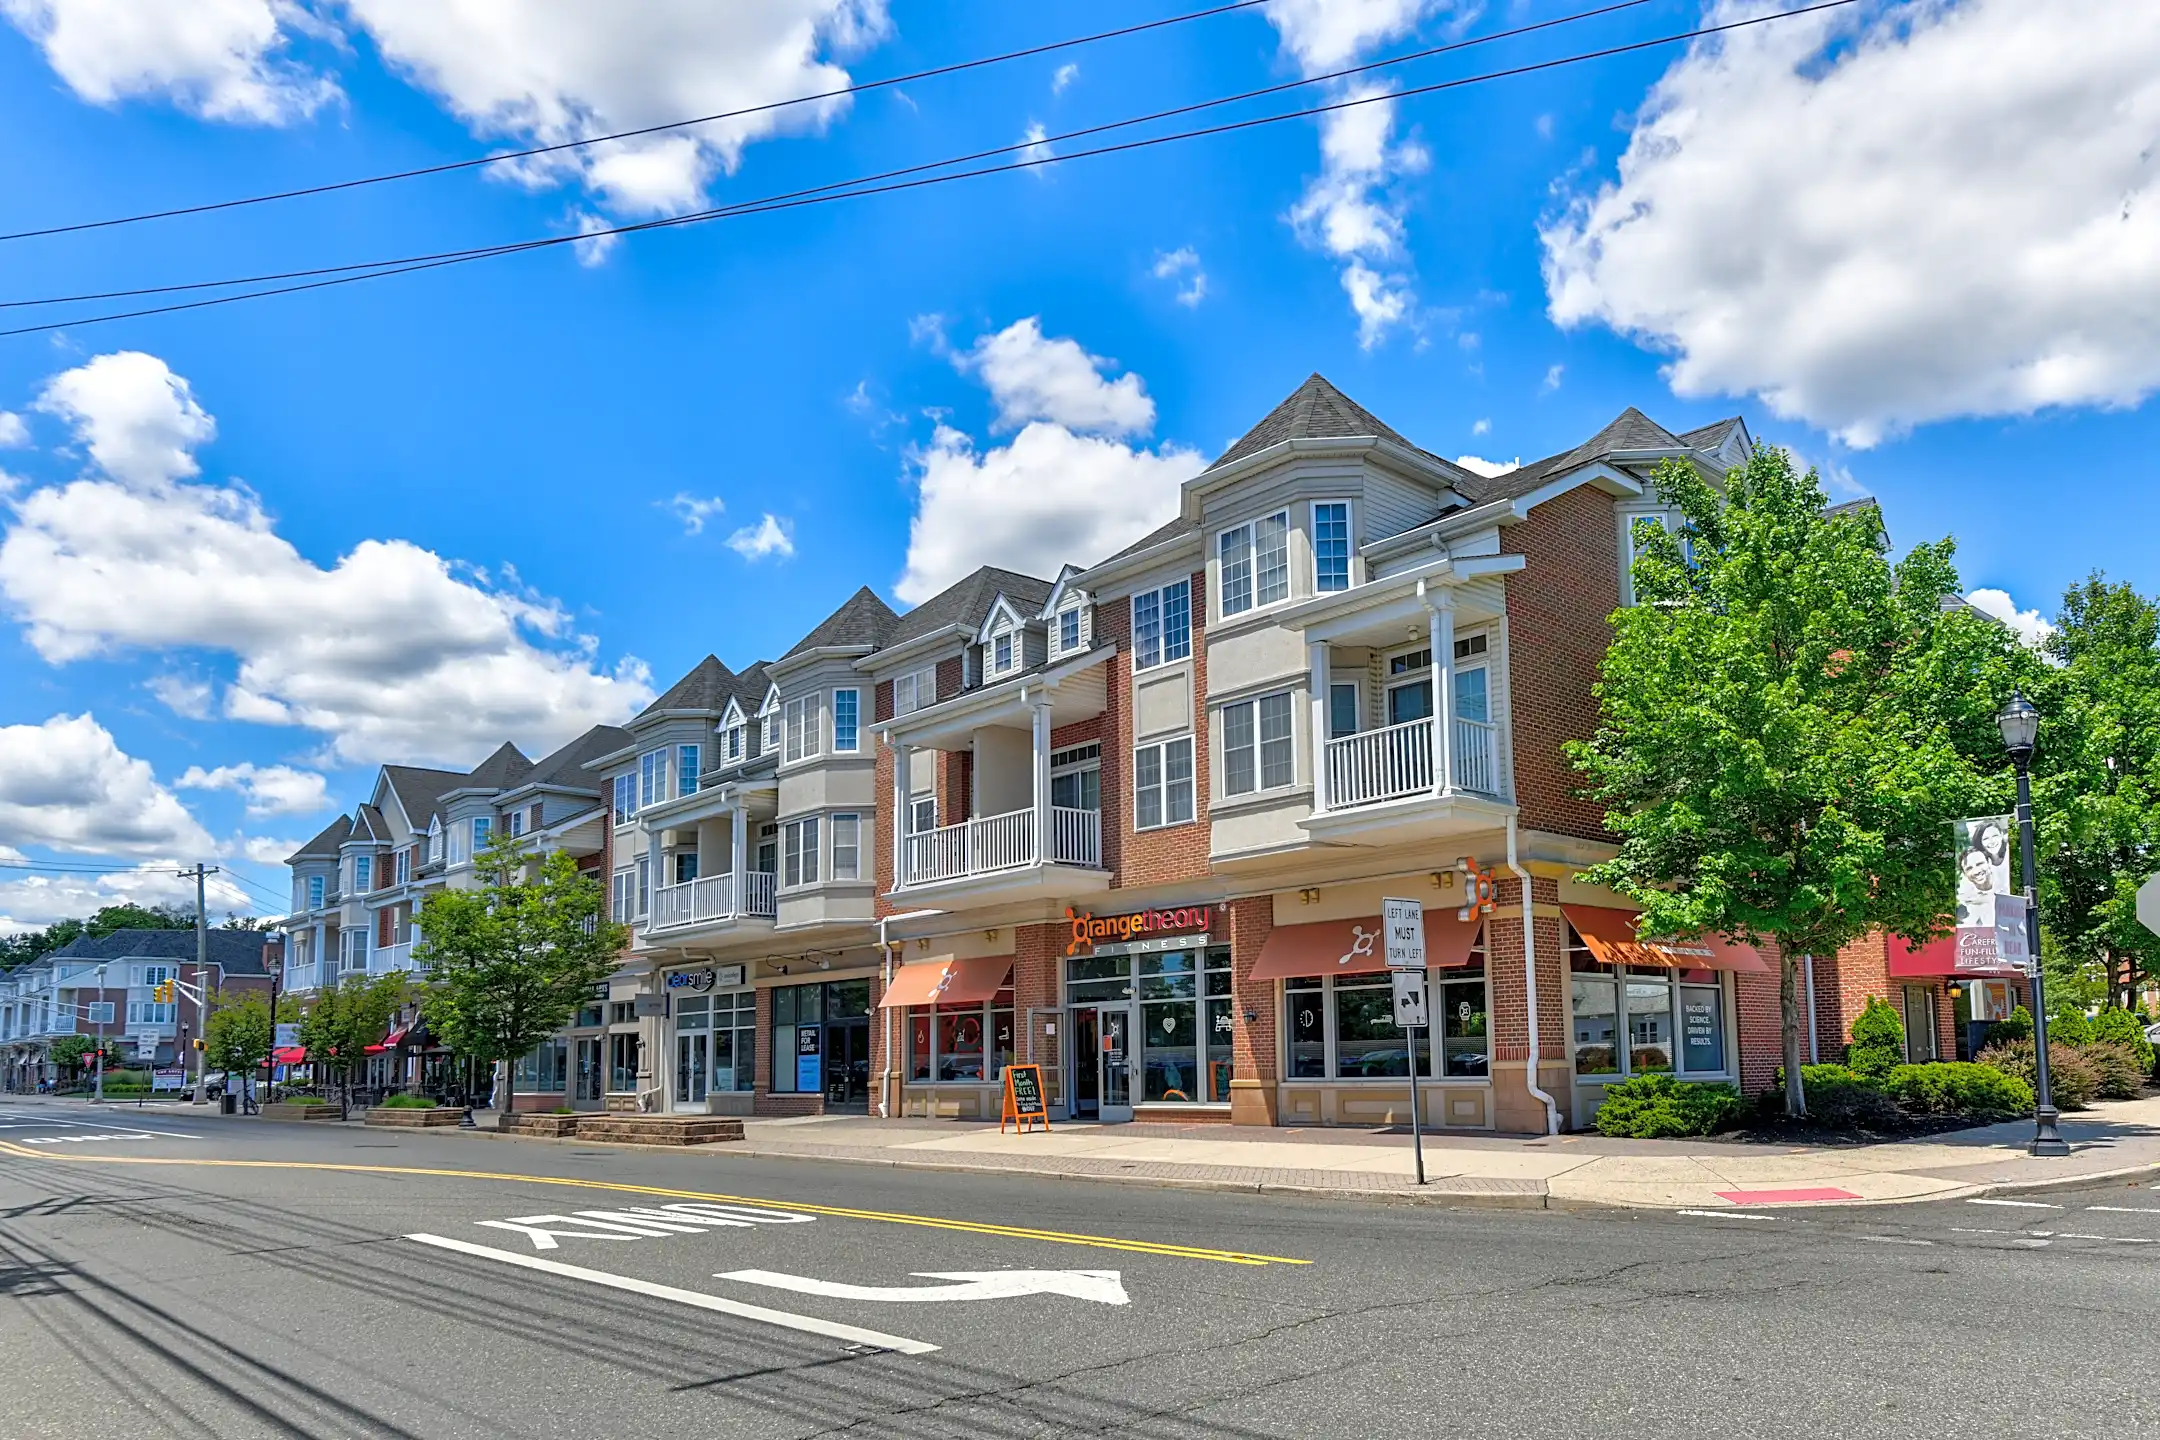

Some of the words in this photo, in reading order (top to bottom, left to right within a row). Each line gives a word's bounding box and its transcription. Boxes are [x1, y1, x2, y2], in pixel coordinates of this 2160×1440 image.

[1387, 908, 1402, 919] LEFT
[1405, 909, 1420, 920] LANE
[1395, 926, 1415, 940] MUST
[1094, 936, 1207, 956] FITNESS
[1389, 947, 1406, 959] TURN
[1408, 948, 1422, 959] LEFT
[1685, 1004, 1704, 1013] BACKED
[1705, 1005, 1711, 1013] BY
[801, 1029, 816, 1037] RETAIL
[1687, 1026, 1705, 1035] DRIVEN
[1705, 1026, 1712, 1035] BY
[801, 1044, 815, 1052] LEASE
[1012, 1070, 1027, 1079] First
[1014, 1079, 1033, 1087] Month
[1015, 1086, 1036, 1096] FREE!
